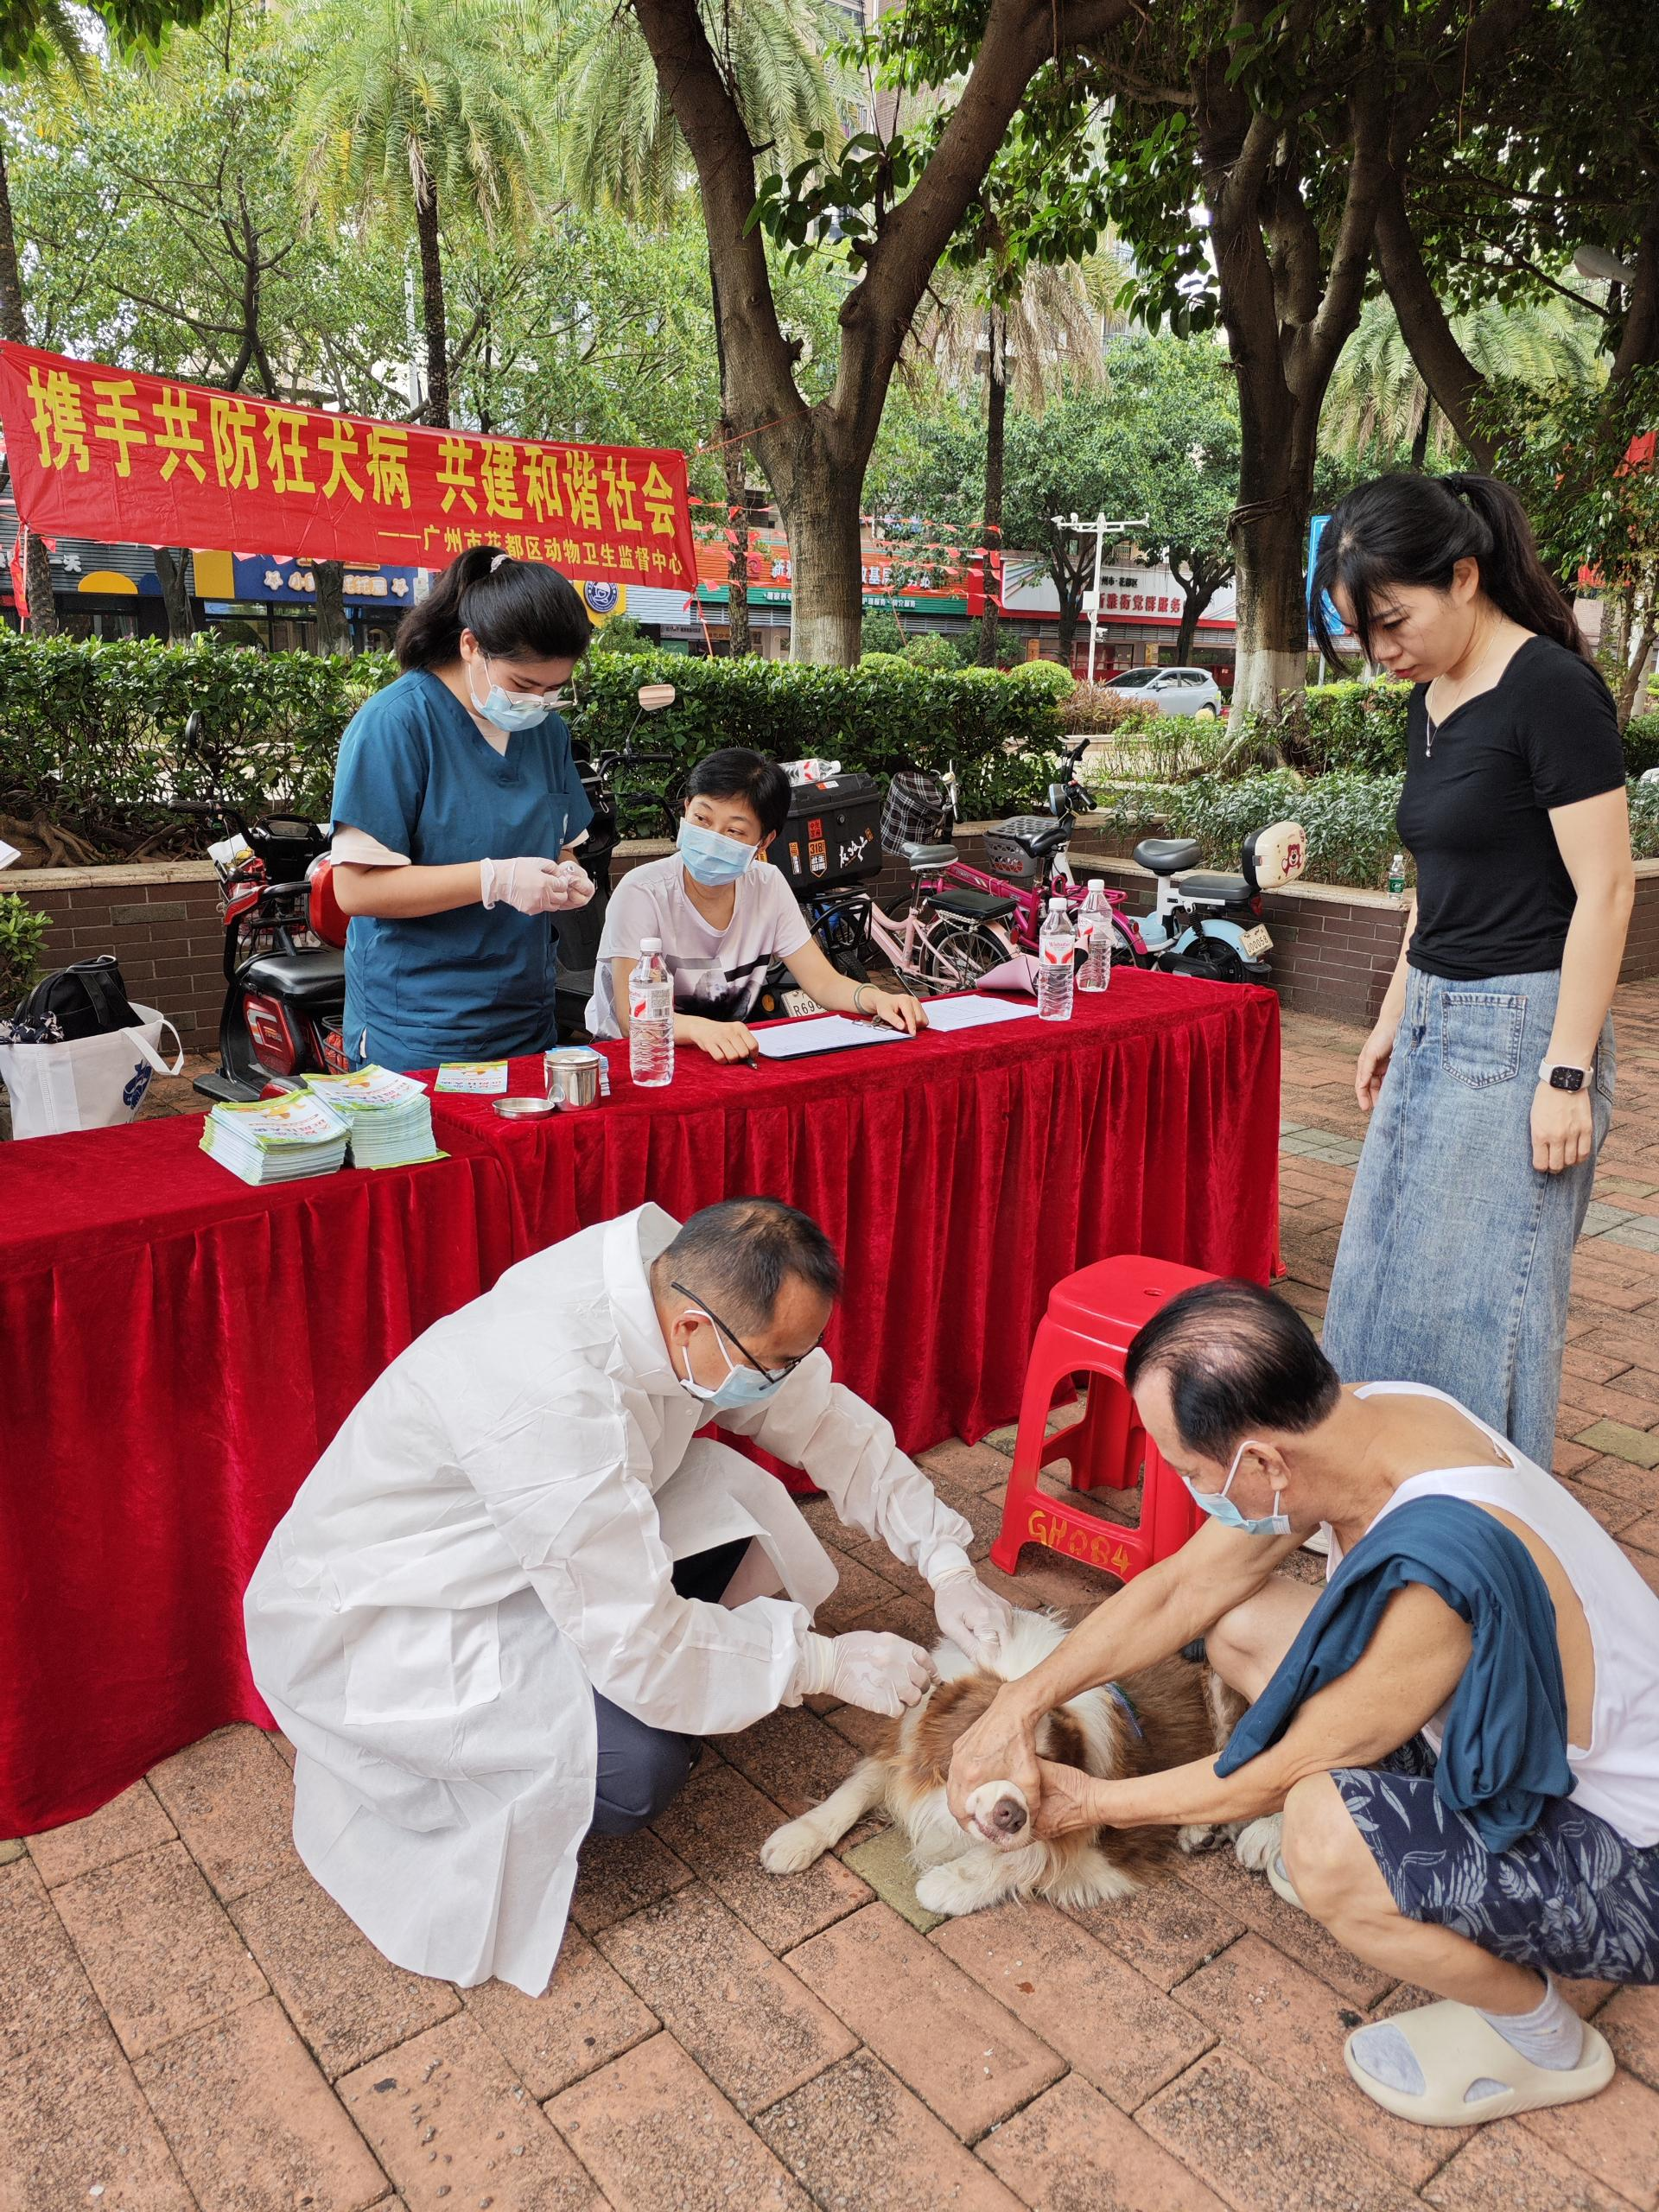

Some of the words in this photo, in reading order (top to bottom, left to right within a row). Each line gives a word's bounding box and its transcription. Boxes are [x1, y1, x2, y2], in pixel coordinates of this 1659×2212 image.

[27, 366, 412, 509] 携手共防狂犬病
[436, 437, 677, 538] 共建和谐社会
